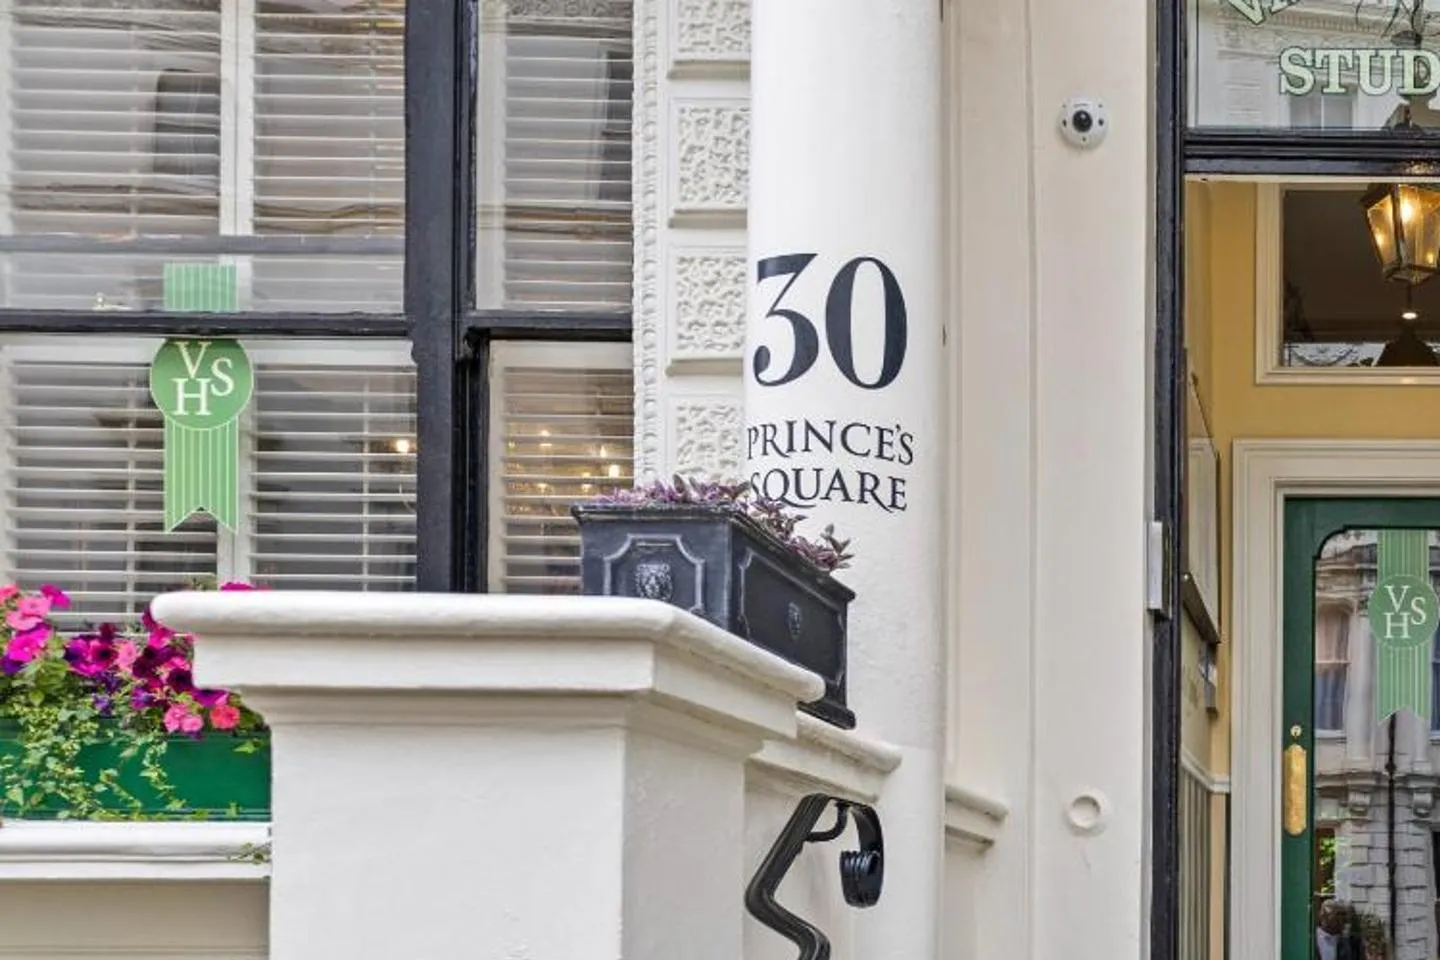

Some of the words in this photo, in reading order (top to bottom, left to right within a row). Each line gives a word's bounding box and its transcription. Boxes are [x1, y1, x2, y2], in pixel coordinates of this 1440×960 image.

[753, 253, 907, 389] 30
[747, 418, 914, 466] PRINCE'S
[750, 468, 908, 513] SQUARE
